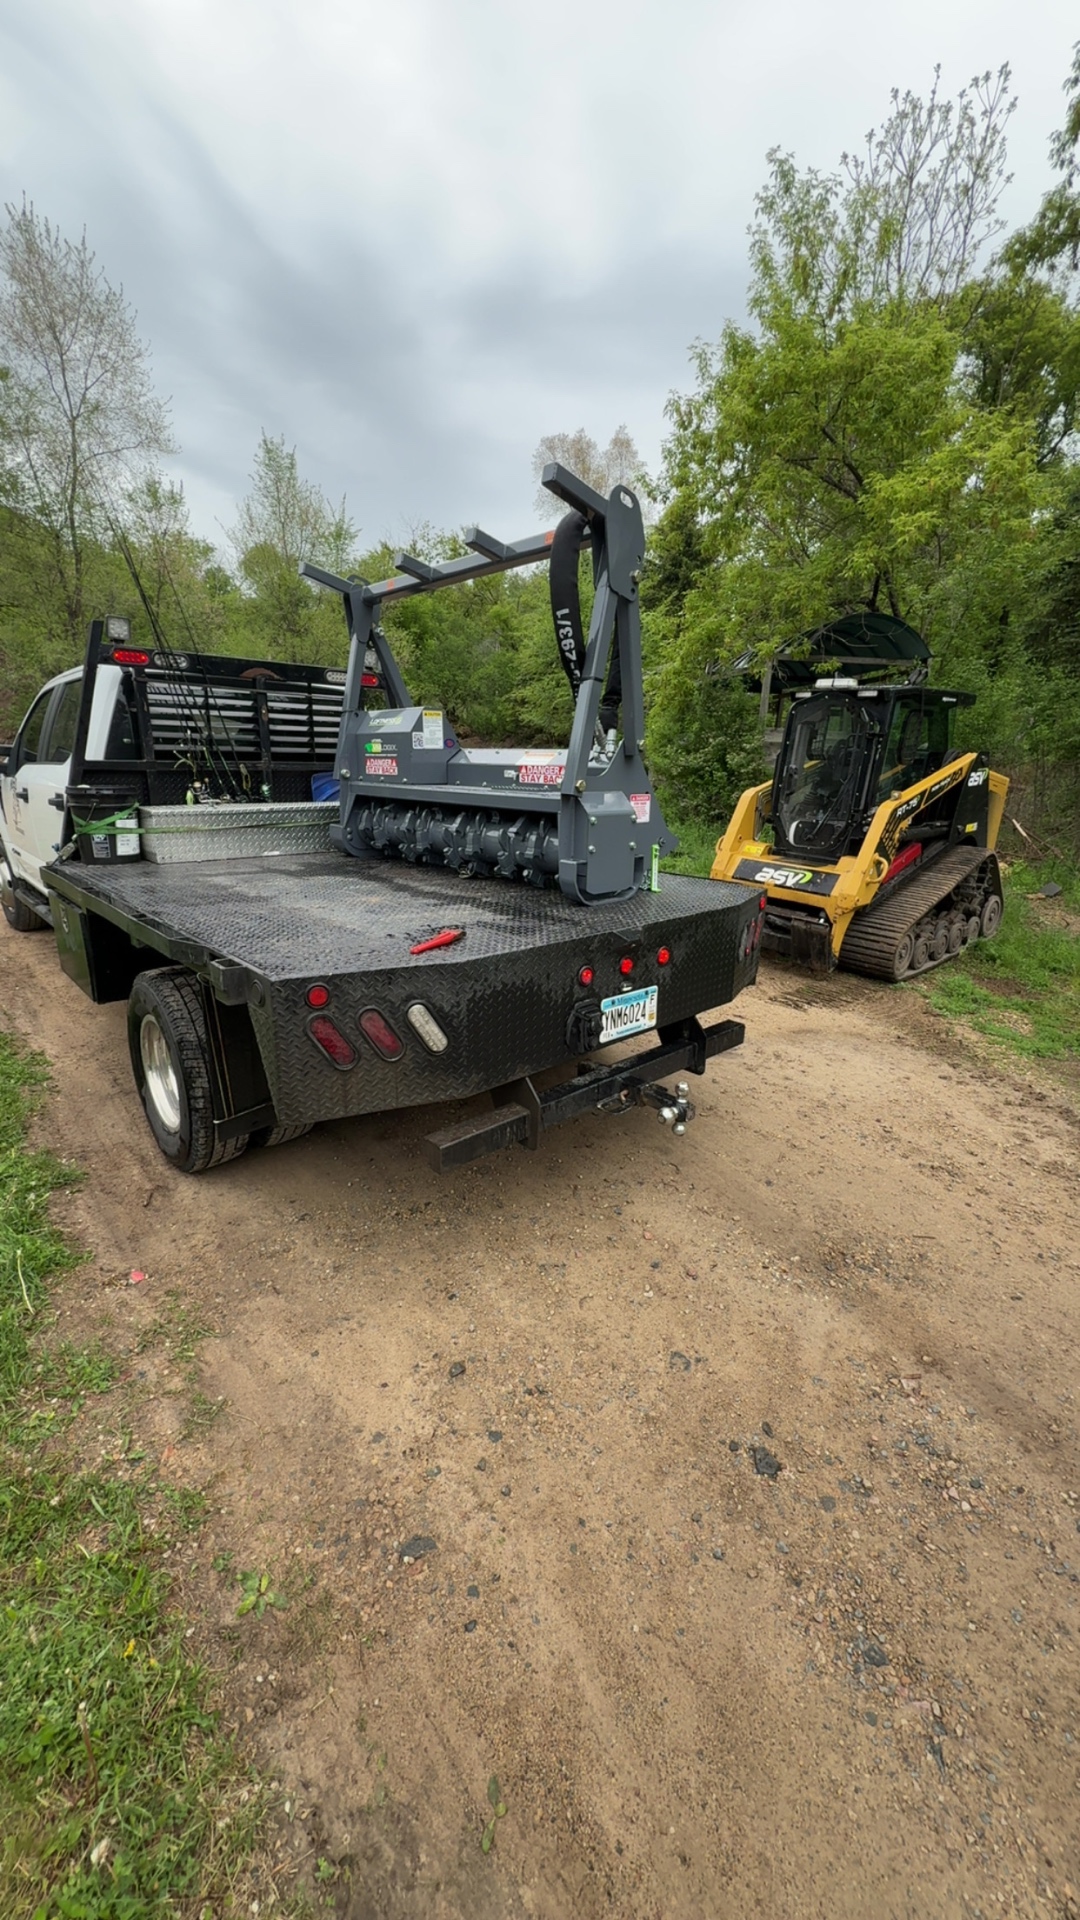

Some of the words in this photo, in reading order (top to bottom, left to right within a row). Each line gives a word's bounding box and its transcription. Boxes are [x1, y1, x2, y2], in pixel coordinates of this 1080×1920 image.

[371, 759, 392, 767] DANGER
[367, 766, 380, 774] STAY
[381, 767, 397, 775] BACK
[526, 766, 560, 775] DANGER
[521, 775, 541, 783] STAY
[543, 776, 563, 784] BAC
[896, 797, 918, 817] RT-75
[605, 1000, 646, 1031] YNM6024
